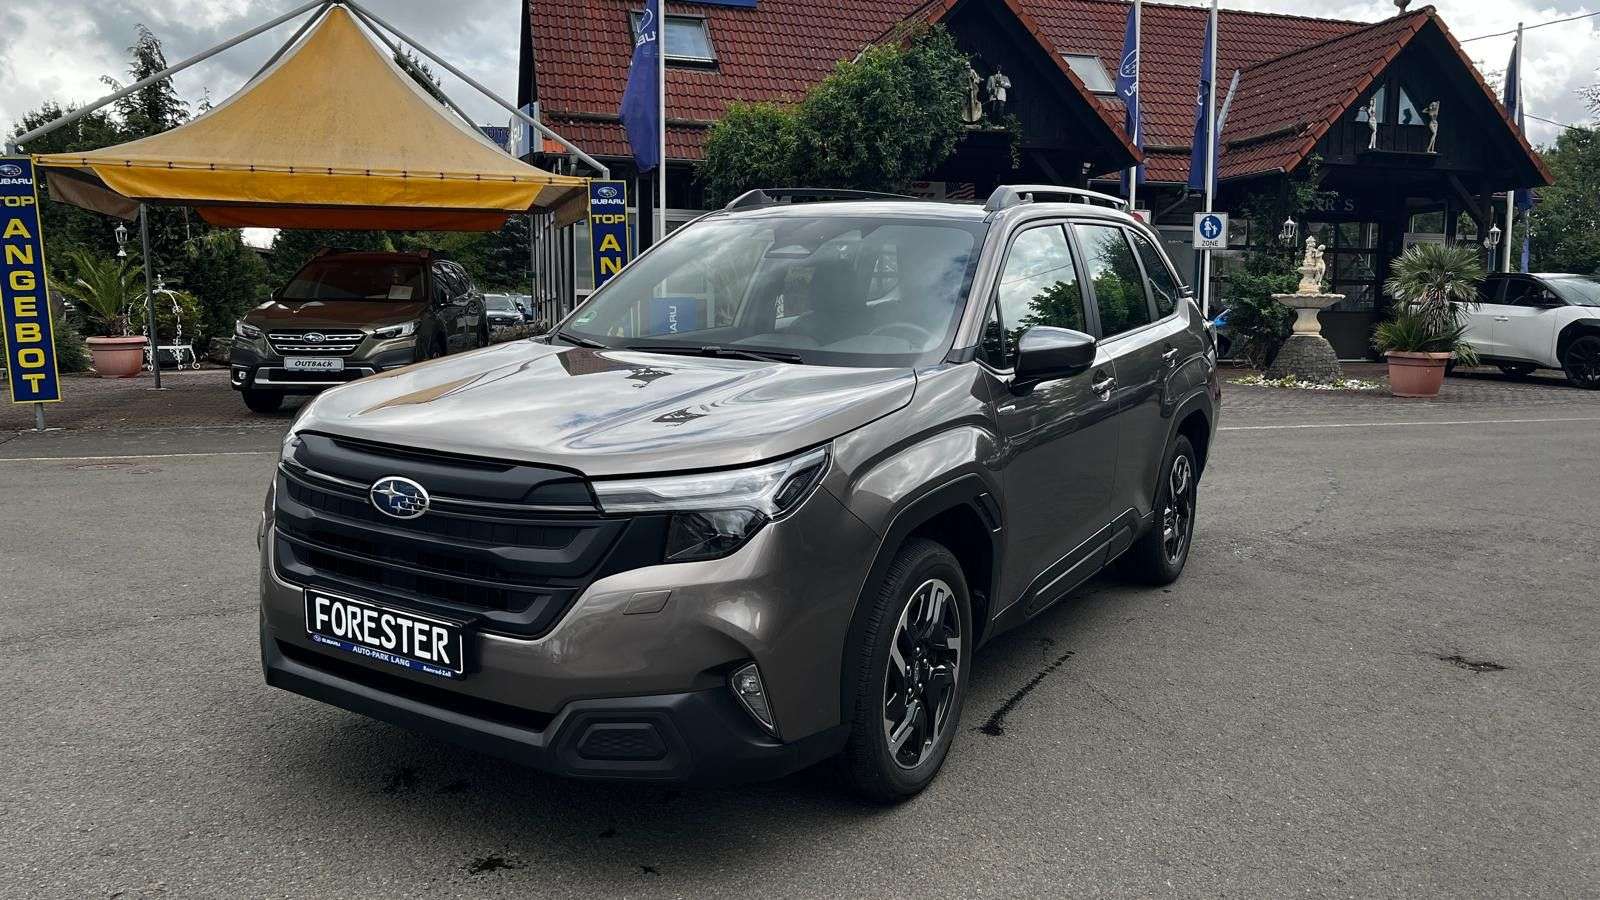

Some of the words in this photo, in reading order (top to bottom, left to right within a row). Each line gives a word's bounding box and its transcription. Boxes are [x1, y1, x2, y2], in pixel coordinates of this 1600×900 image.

[592, 214, 626, 224] TOP
[599, 233, 622, 280] AN
[3, 218, 46, 393] ANGEBOT
[315, 596, 450, 665] FORESTER
[352, 645, 389, 662] AUTO-PARK
[390, 655, 410, 667] LANG
